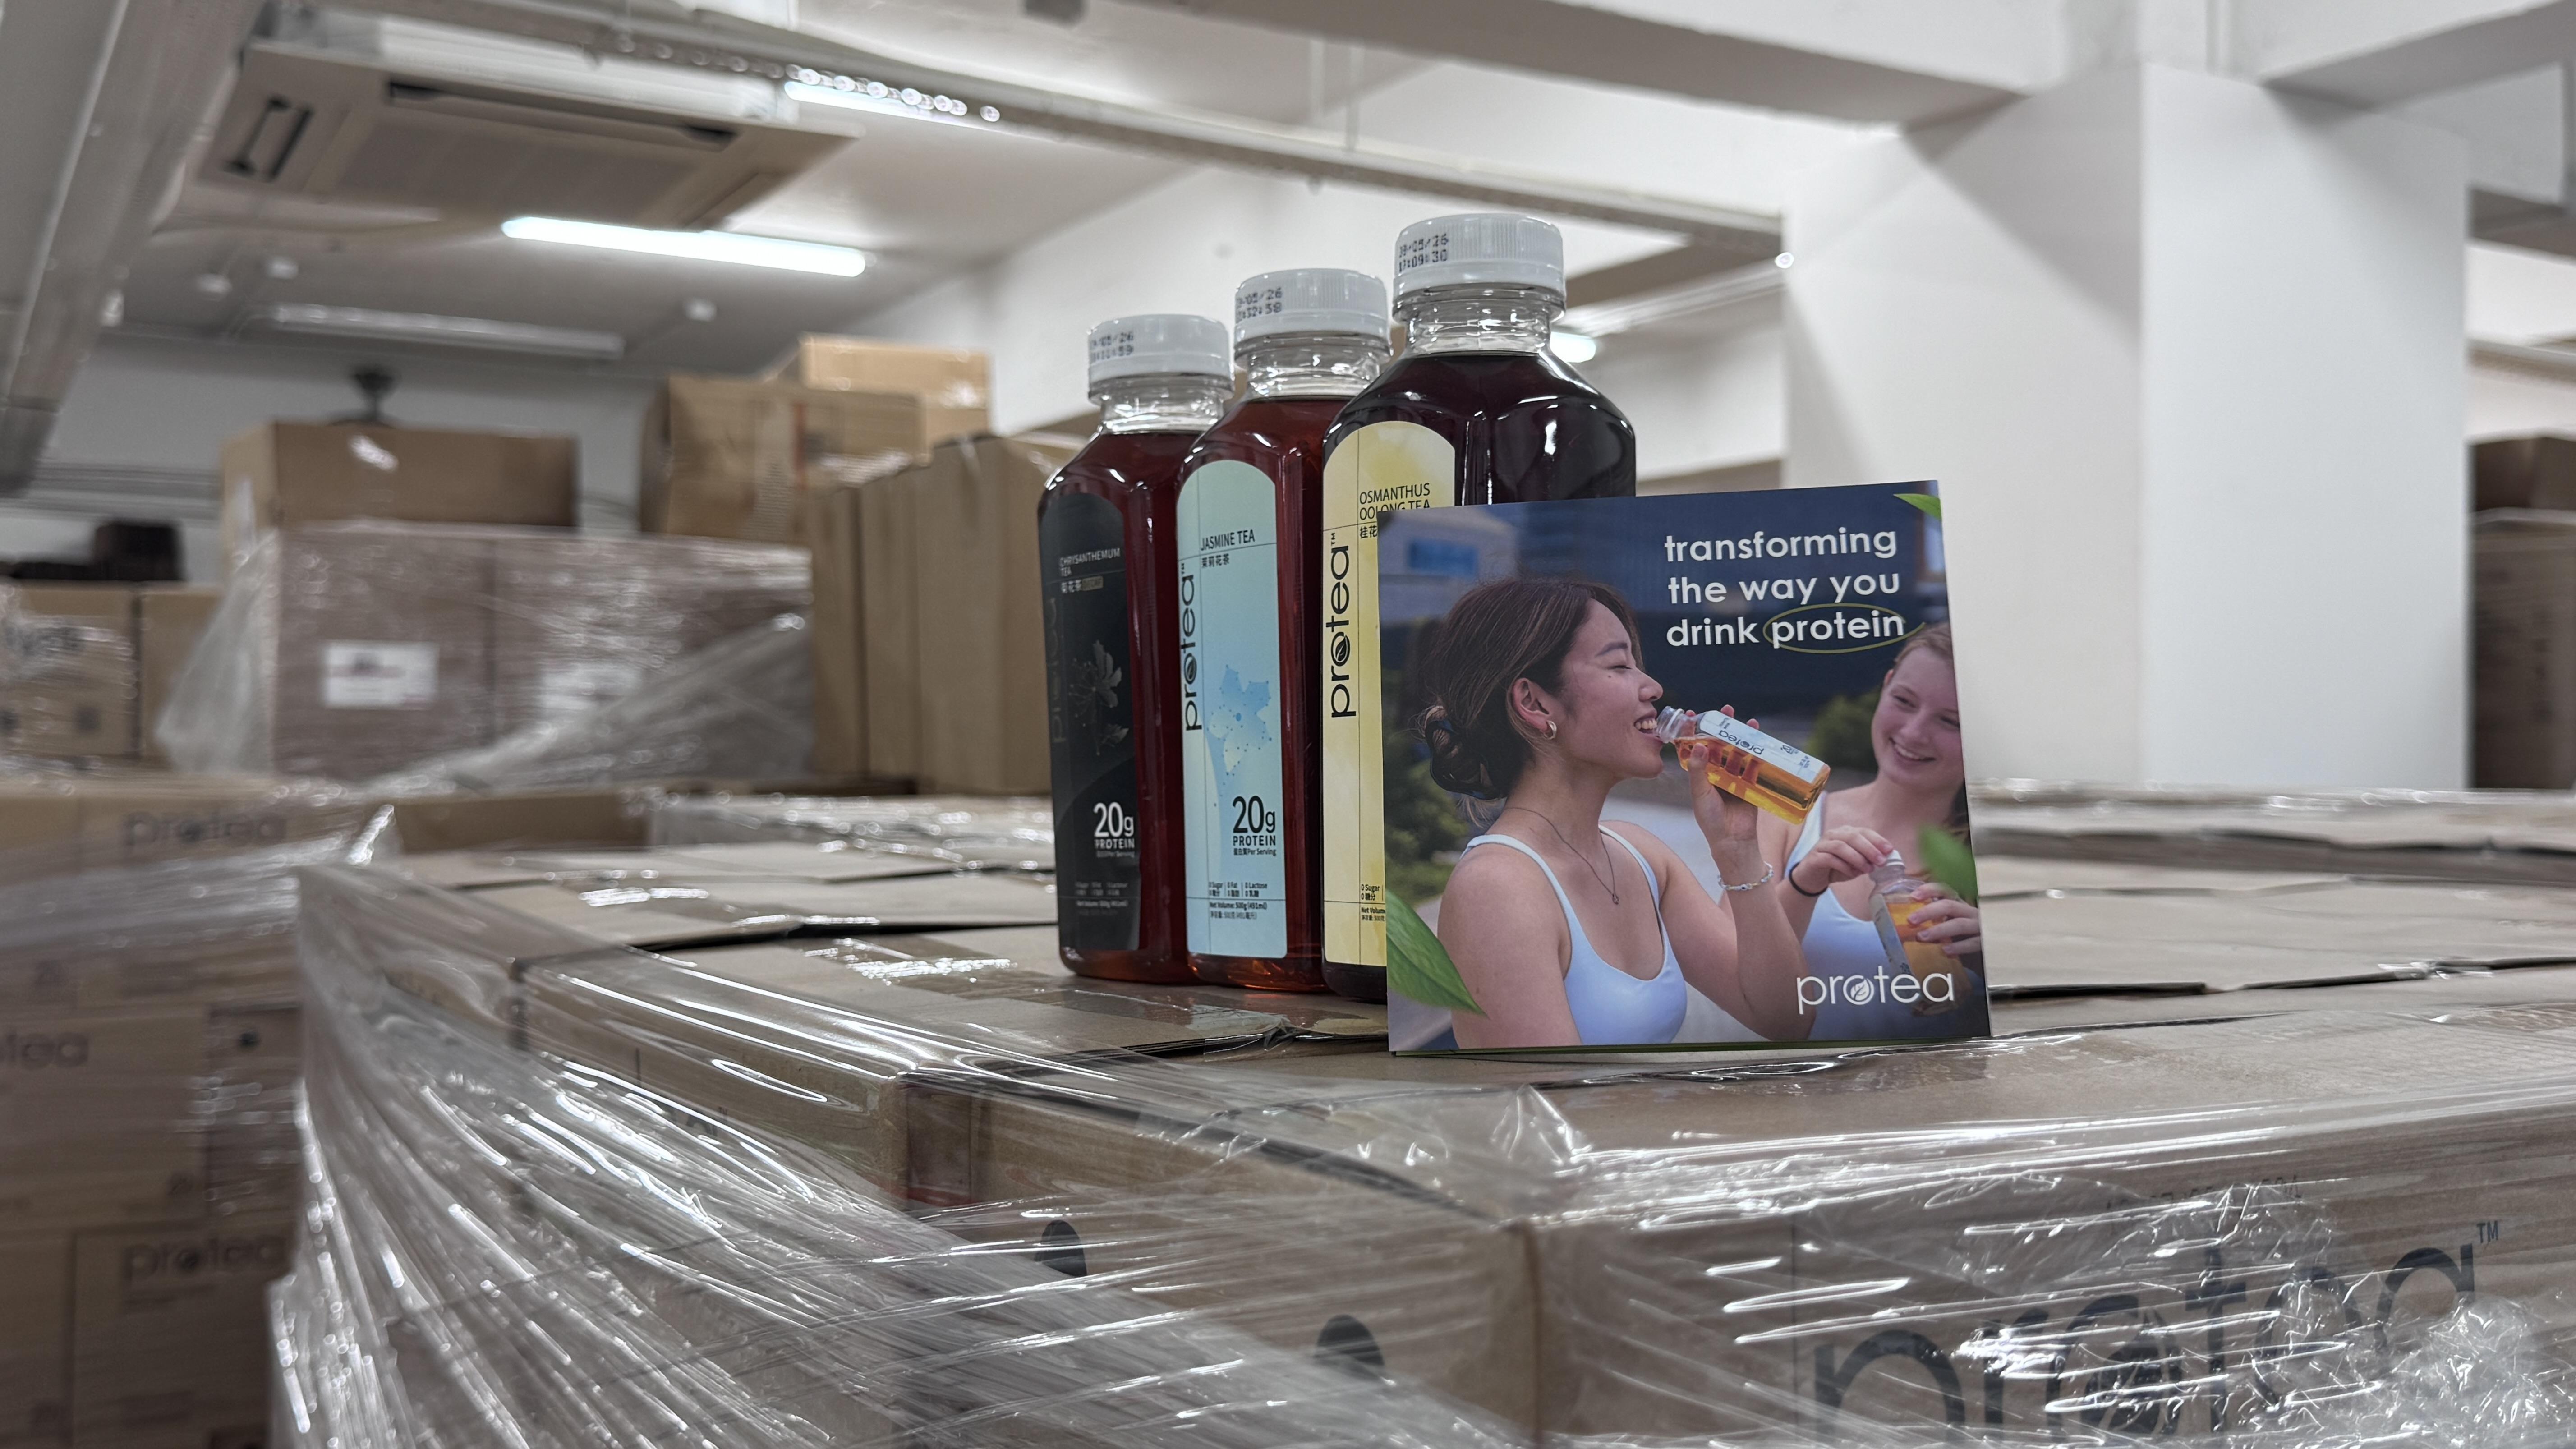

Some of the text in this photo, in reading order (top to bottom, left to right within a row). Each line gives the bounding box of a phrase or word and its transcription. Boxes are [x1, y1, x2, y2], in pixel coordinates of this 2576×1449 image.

[1360, 483, 1430, 505] OSMANTHUS
[1201, 529, 1255, 551] JASMINE TEA
[1665, 527, 1897, 562] transforming
[1060, 548, 1121, 567] CHRYSANTHEMUM
[1060, 566, 1072, 577] TEA
[1668, 573, 1900, 604] the way you
[1667, 610, 1904, 649] drink protein
[1719, 729, 1765, 755] protea
[1094, 802, 1134, 837] 20g
[1233, 796, 1276, 833] 20g
[1094, 838, 1135, 849] PROTEIN
[1233, 835, 1276, 846] PROTEIN
[1365, 884, 1380, 893] Sugar
[1797, 966, 1954, 1015] protea
